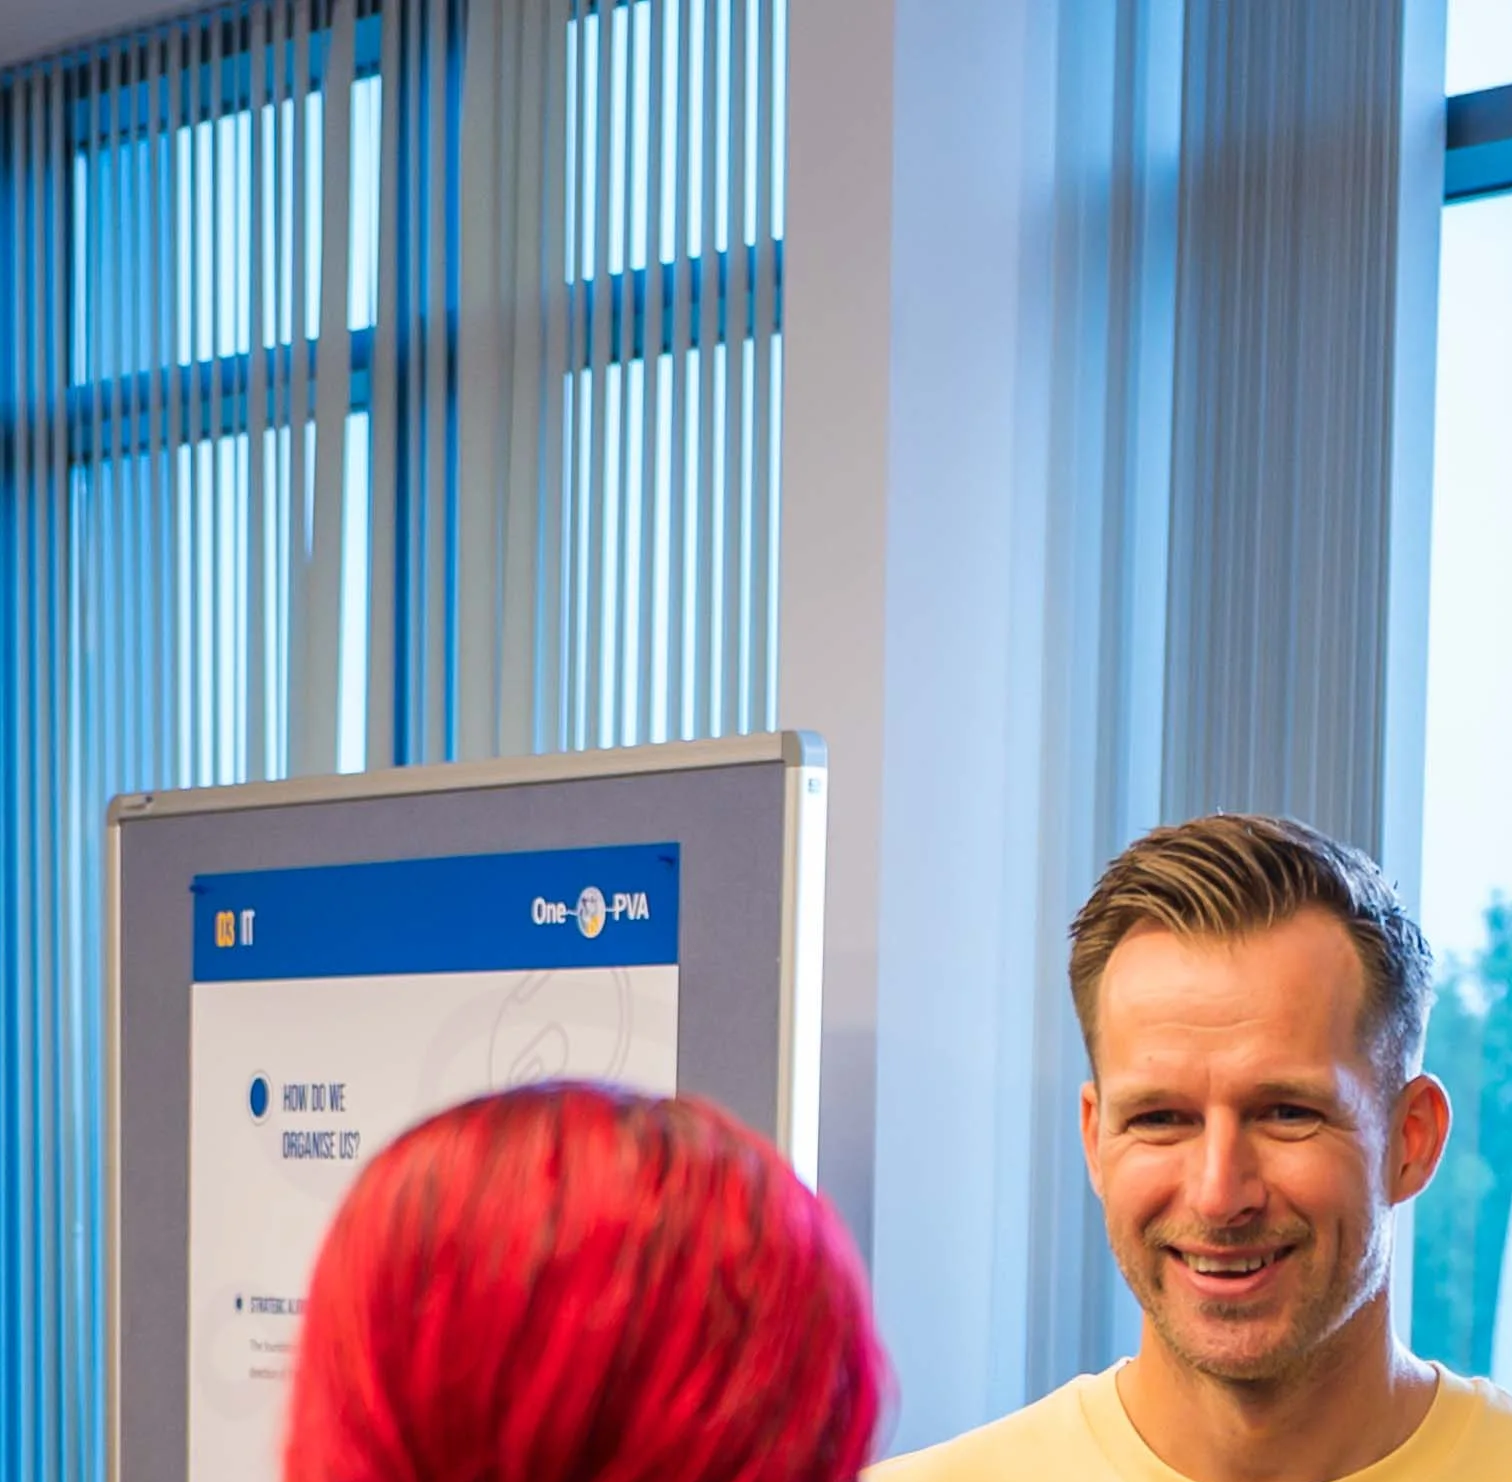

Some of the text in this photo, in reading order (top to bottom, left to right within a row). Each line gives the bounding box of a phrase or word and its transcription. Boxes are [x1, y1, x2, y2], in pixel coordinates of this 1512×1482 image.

[531, 892, 650, 925] One PVA
[241, 908, 256, 946] IT
[283, 1083, 346, 1112] HOW DO WE
[283, 1131, 336, 1160] ORGANISE
